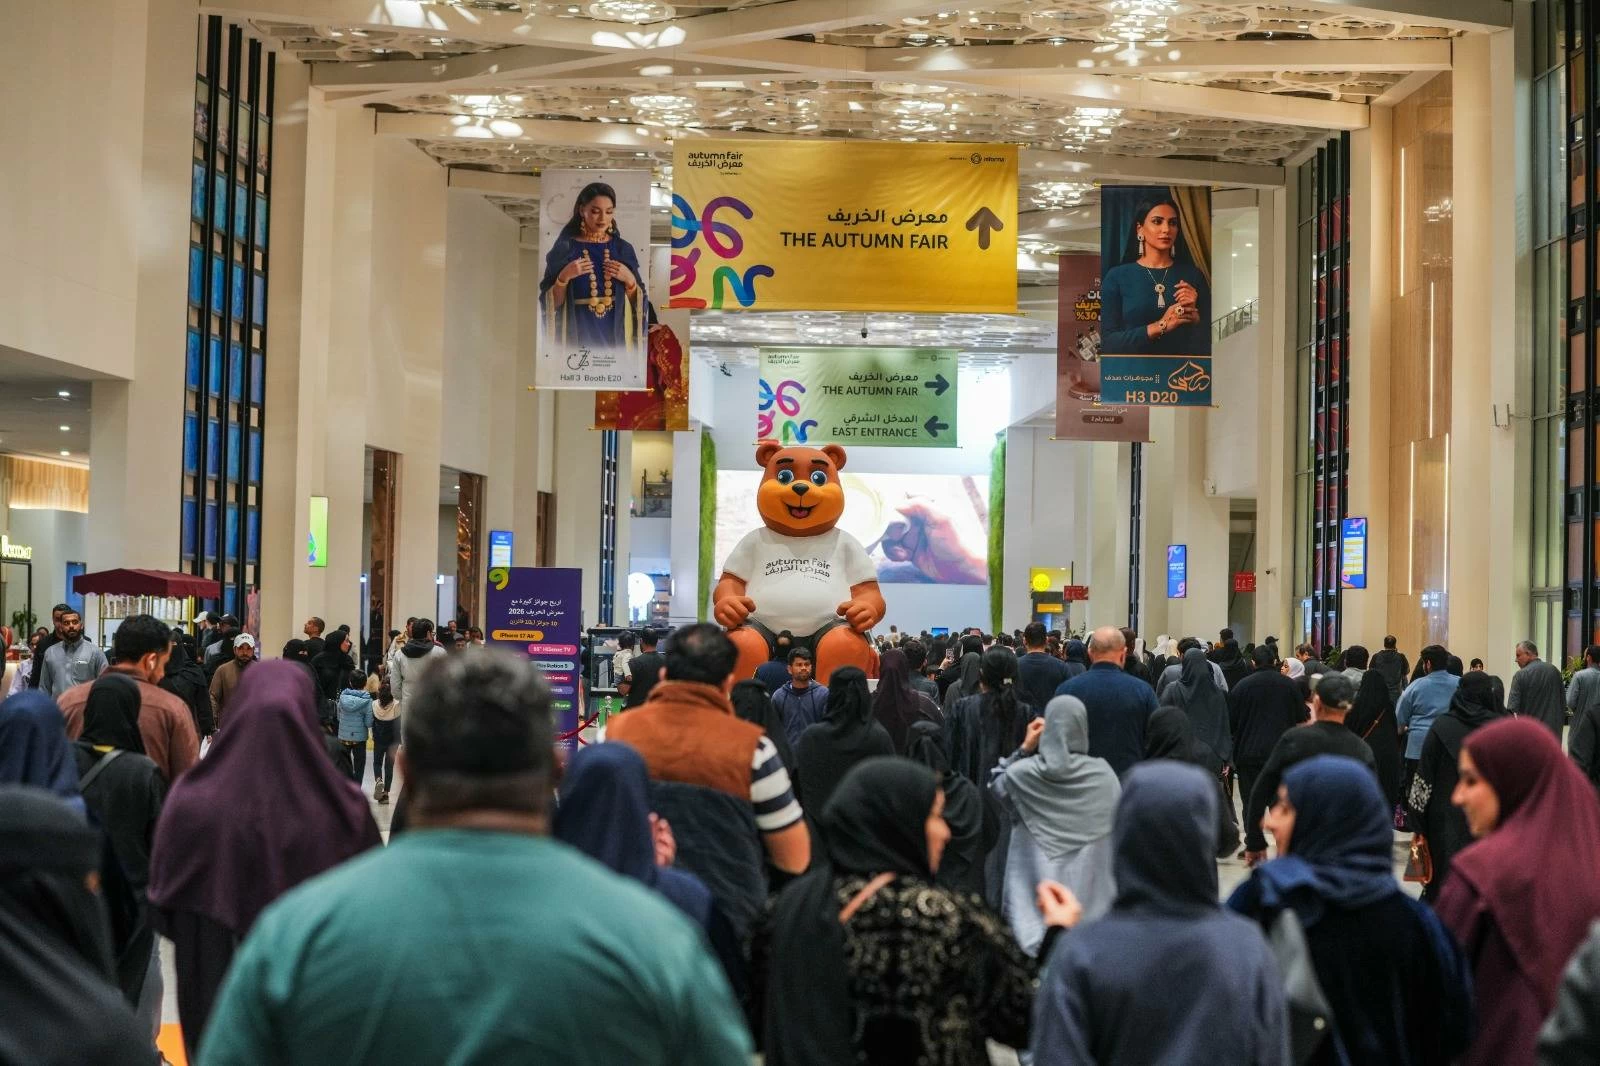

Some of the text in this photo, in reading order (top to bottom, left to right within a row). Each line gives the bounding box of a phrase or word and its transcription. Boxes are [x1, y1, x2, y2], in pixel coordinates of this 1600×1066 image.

[688, 160, 743, 170] معرض الخريف
[828, 208, 948, 226] معرض الخريف
[780, 232, 948, 249] THE AUTUMN FAIR
[848, 372, 918, 382] معرض الخريف
[822, 386, 918, 396] THE AUTUMN FAIR
[1126, 390, 1178, 403] H3 D20
[844, 413, 918, 426] المدخل الشرقي
[832, 428, 918, 437] EAST ENTRANCE
[766, 558, 810, 569] autumn
[766, 564, 830, 578] معرض الخريف
